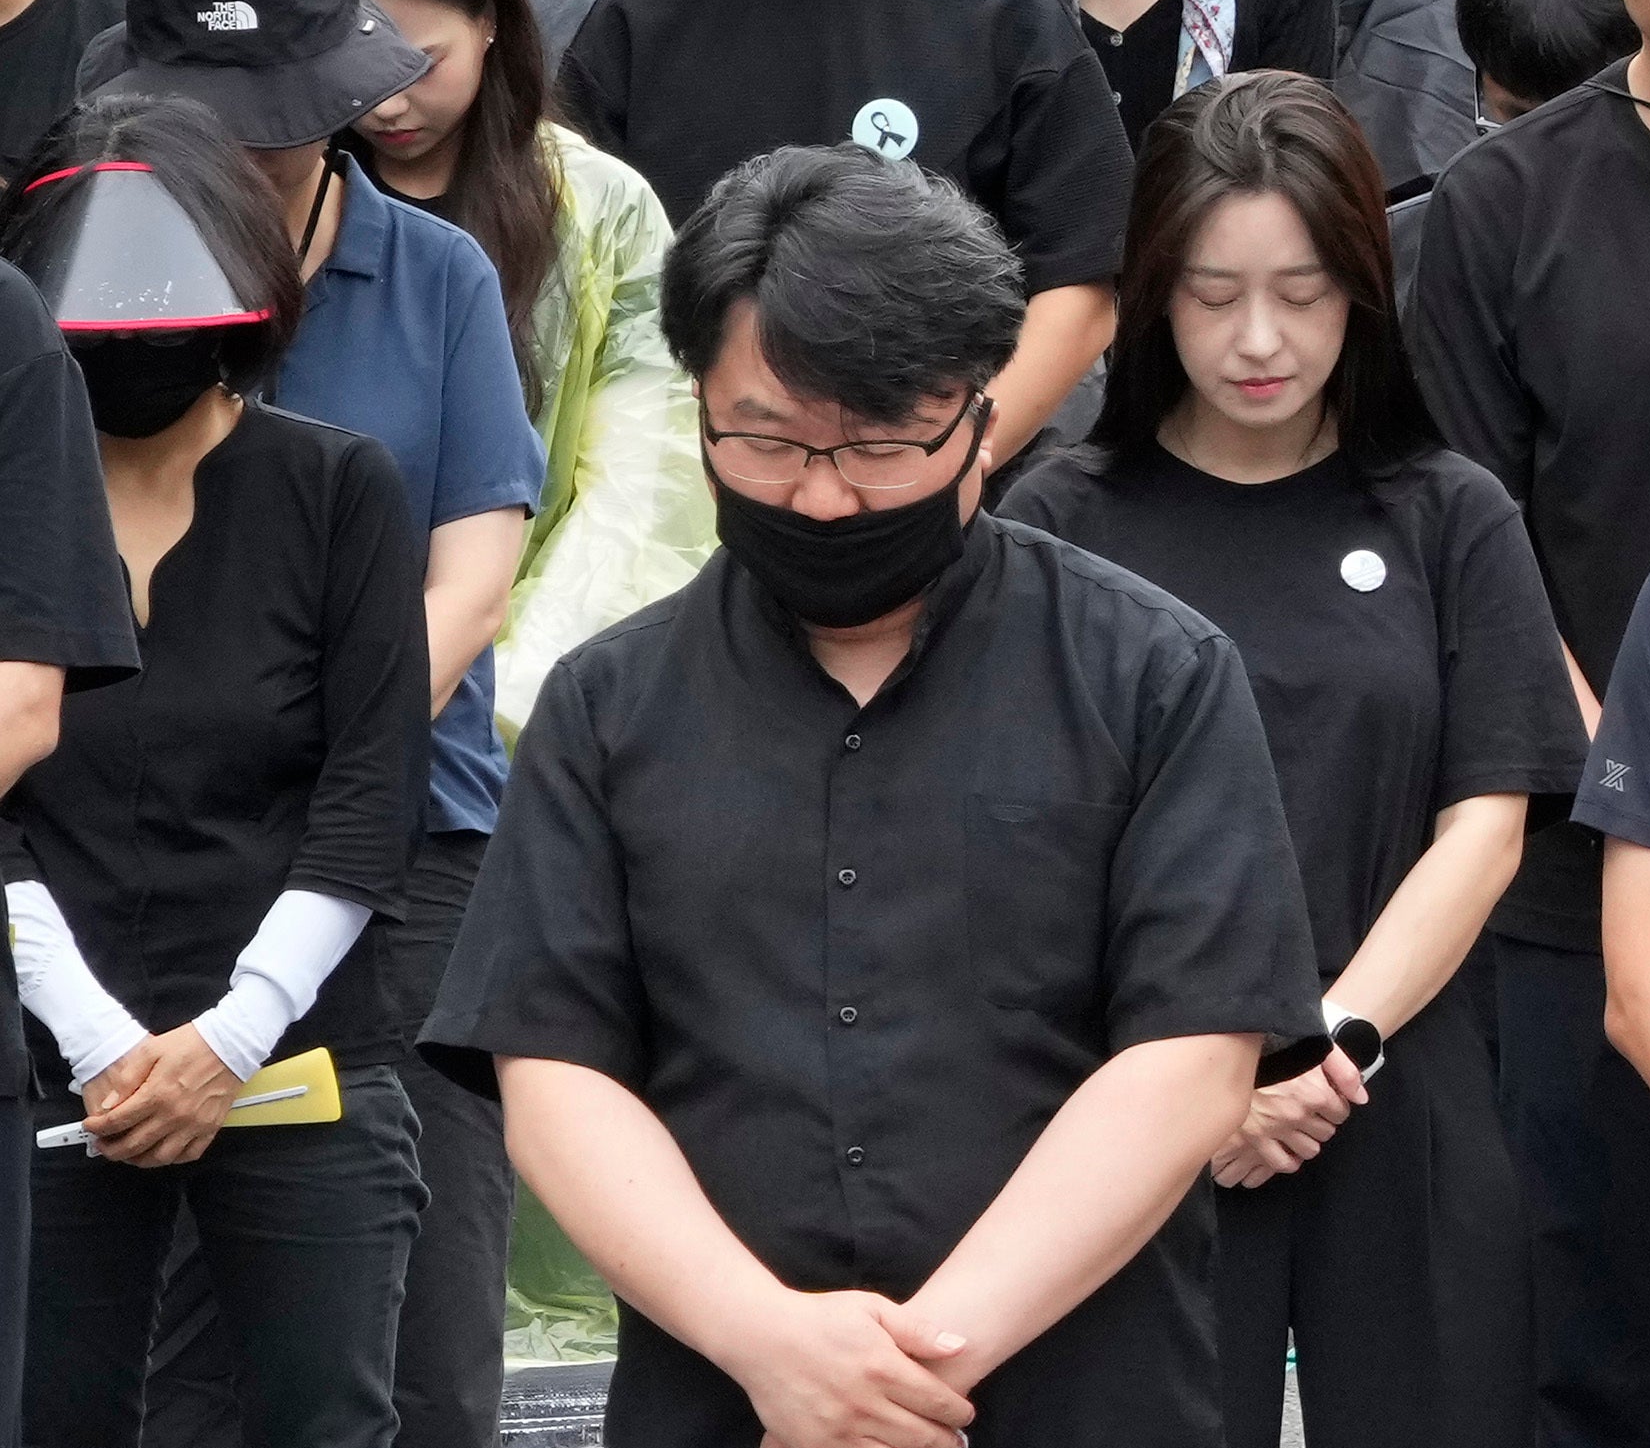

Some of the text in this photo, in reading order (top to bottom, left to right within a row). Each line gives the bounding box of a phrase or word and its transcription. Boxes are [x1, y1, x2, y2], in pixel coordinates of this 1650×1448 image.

[214, 1, 236, 12] THE
[197, 11, 237, 22] NORTH
[208, 21, 236, 31] FACE
